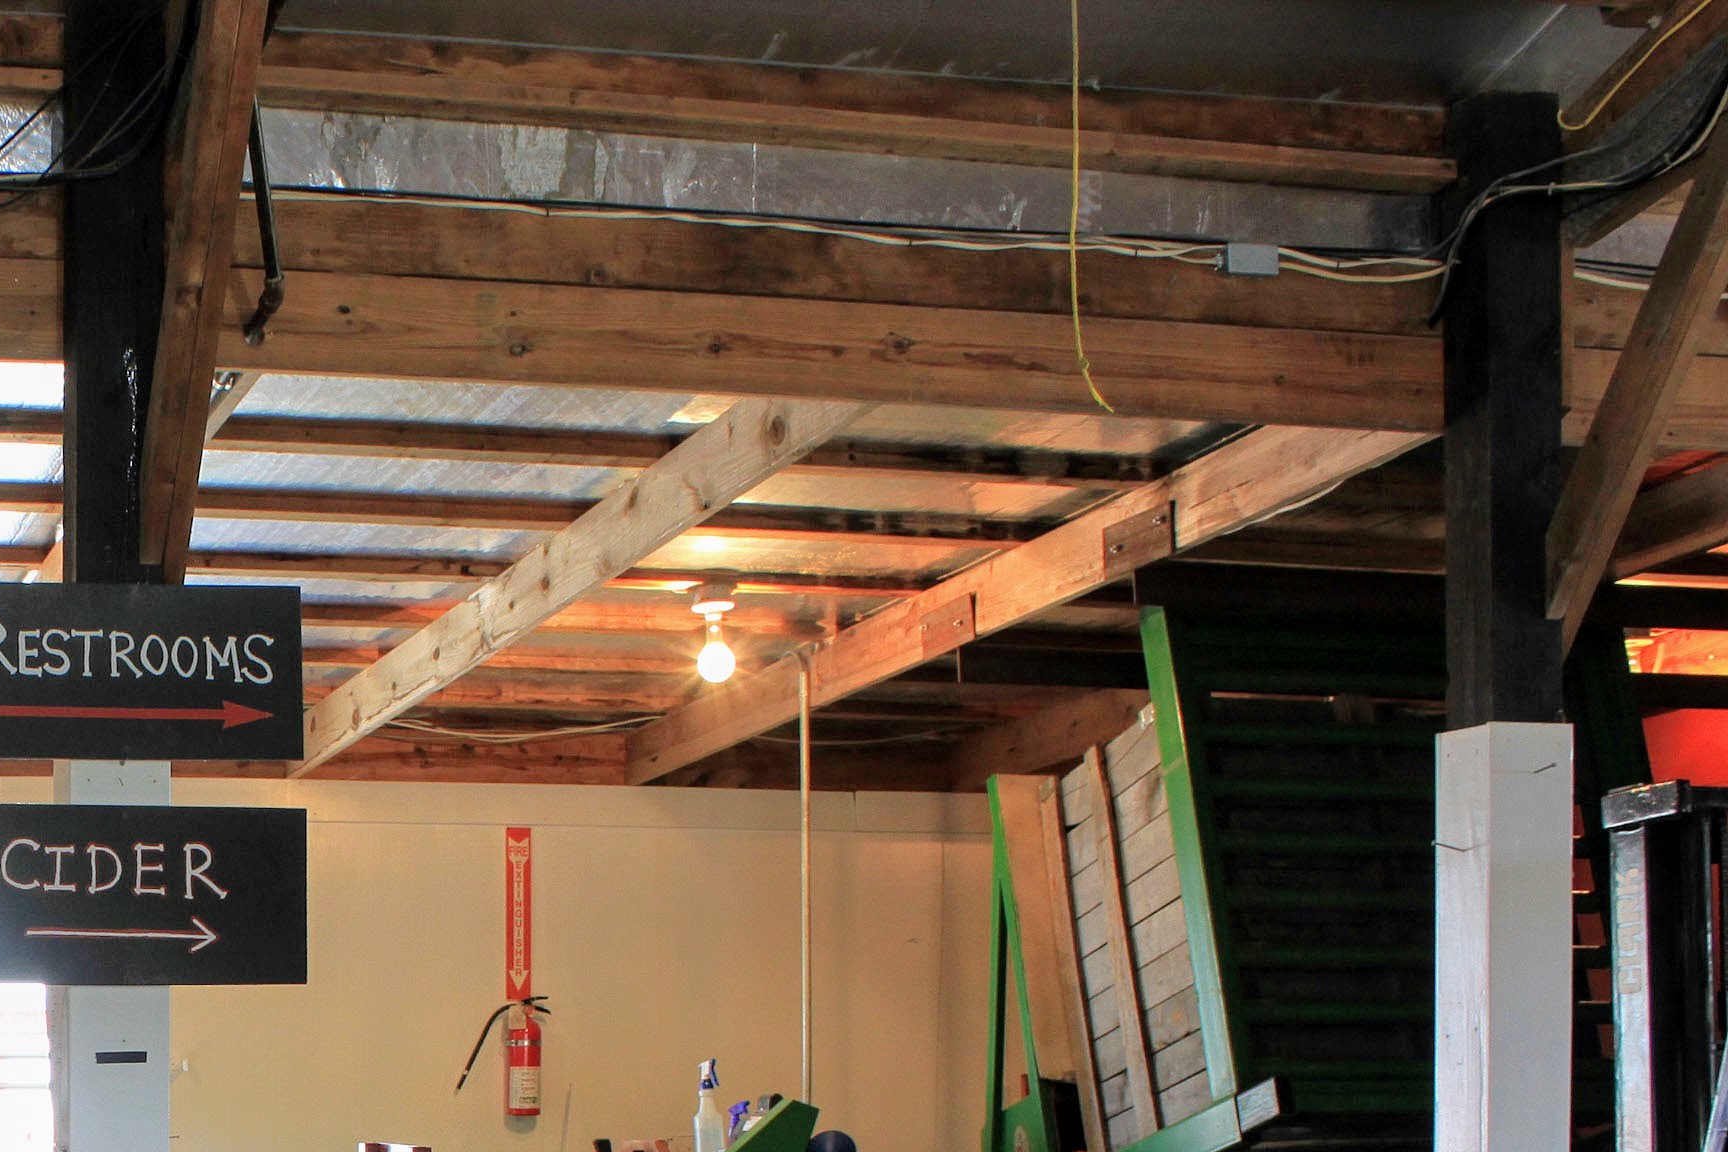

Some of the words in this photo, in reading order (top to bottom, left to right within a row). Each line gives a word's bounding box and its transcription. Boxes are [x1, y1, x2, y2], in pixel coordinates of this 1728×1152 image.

[0, 837, 228, 900] CIDER
[508, 846, 528, 857] FIRE
[514, 860, 524, 977] EXTINGUISHER
[1615, 867, 1642, 995] CLARK
